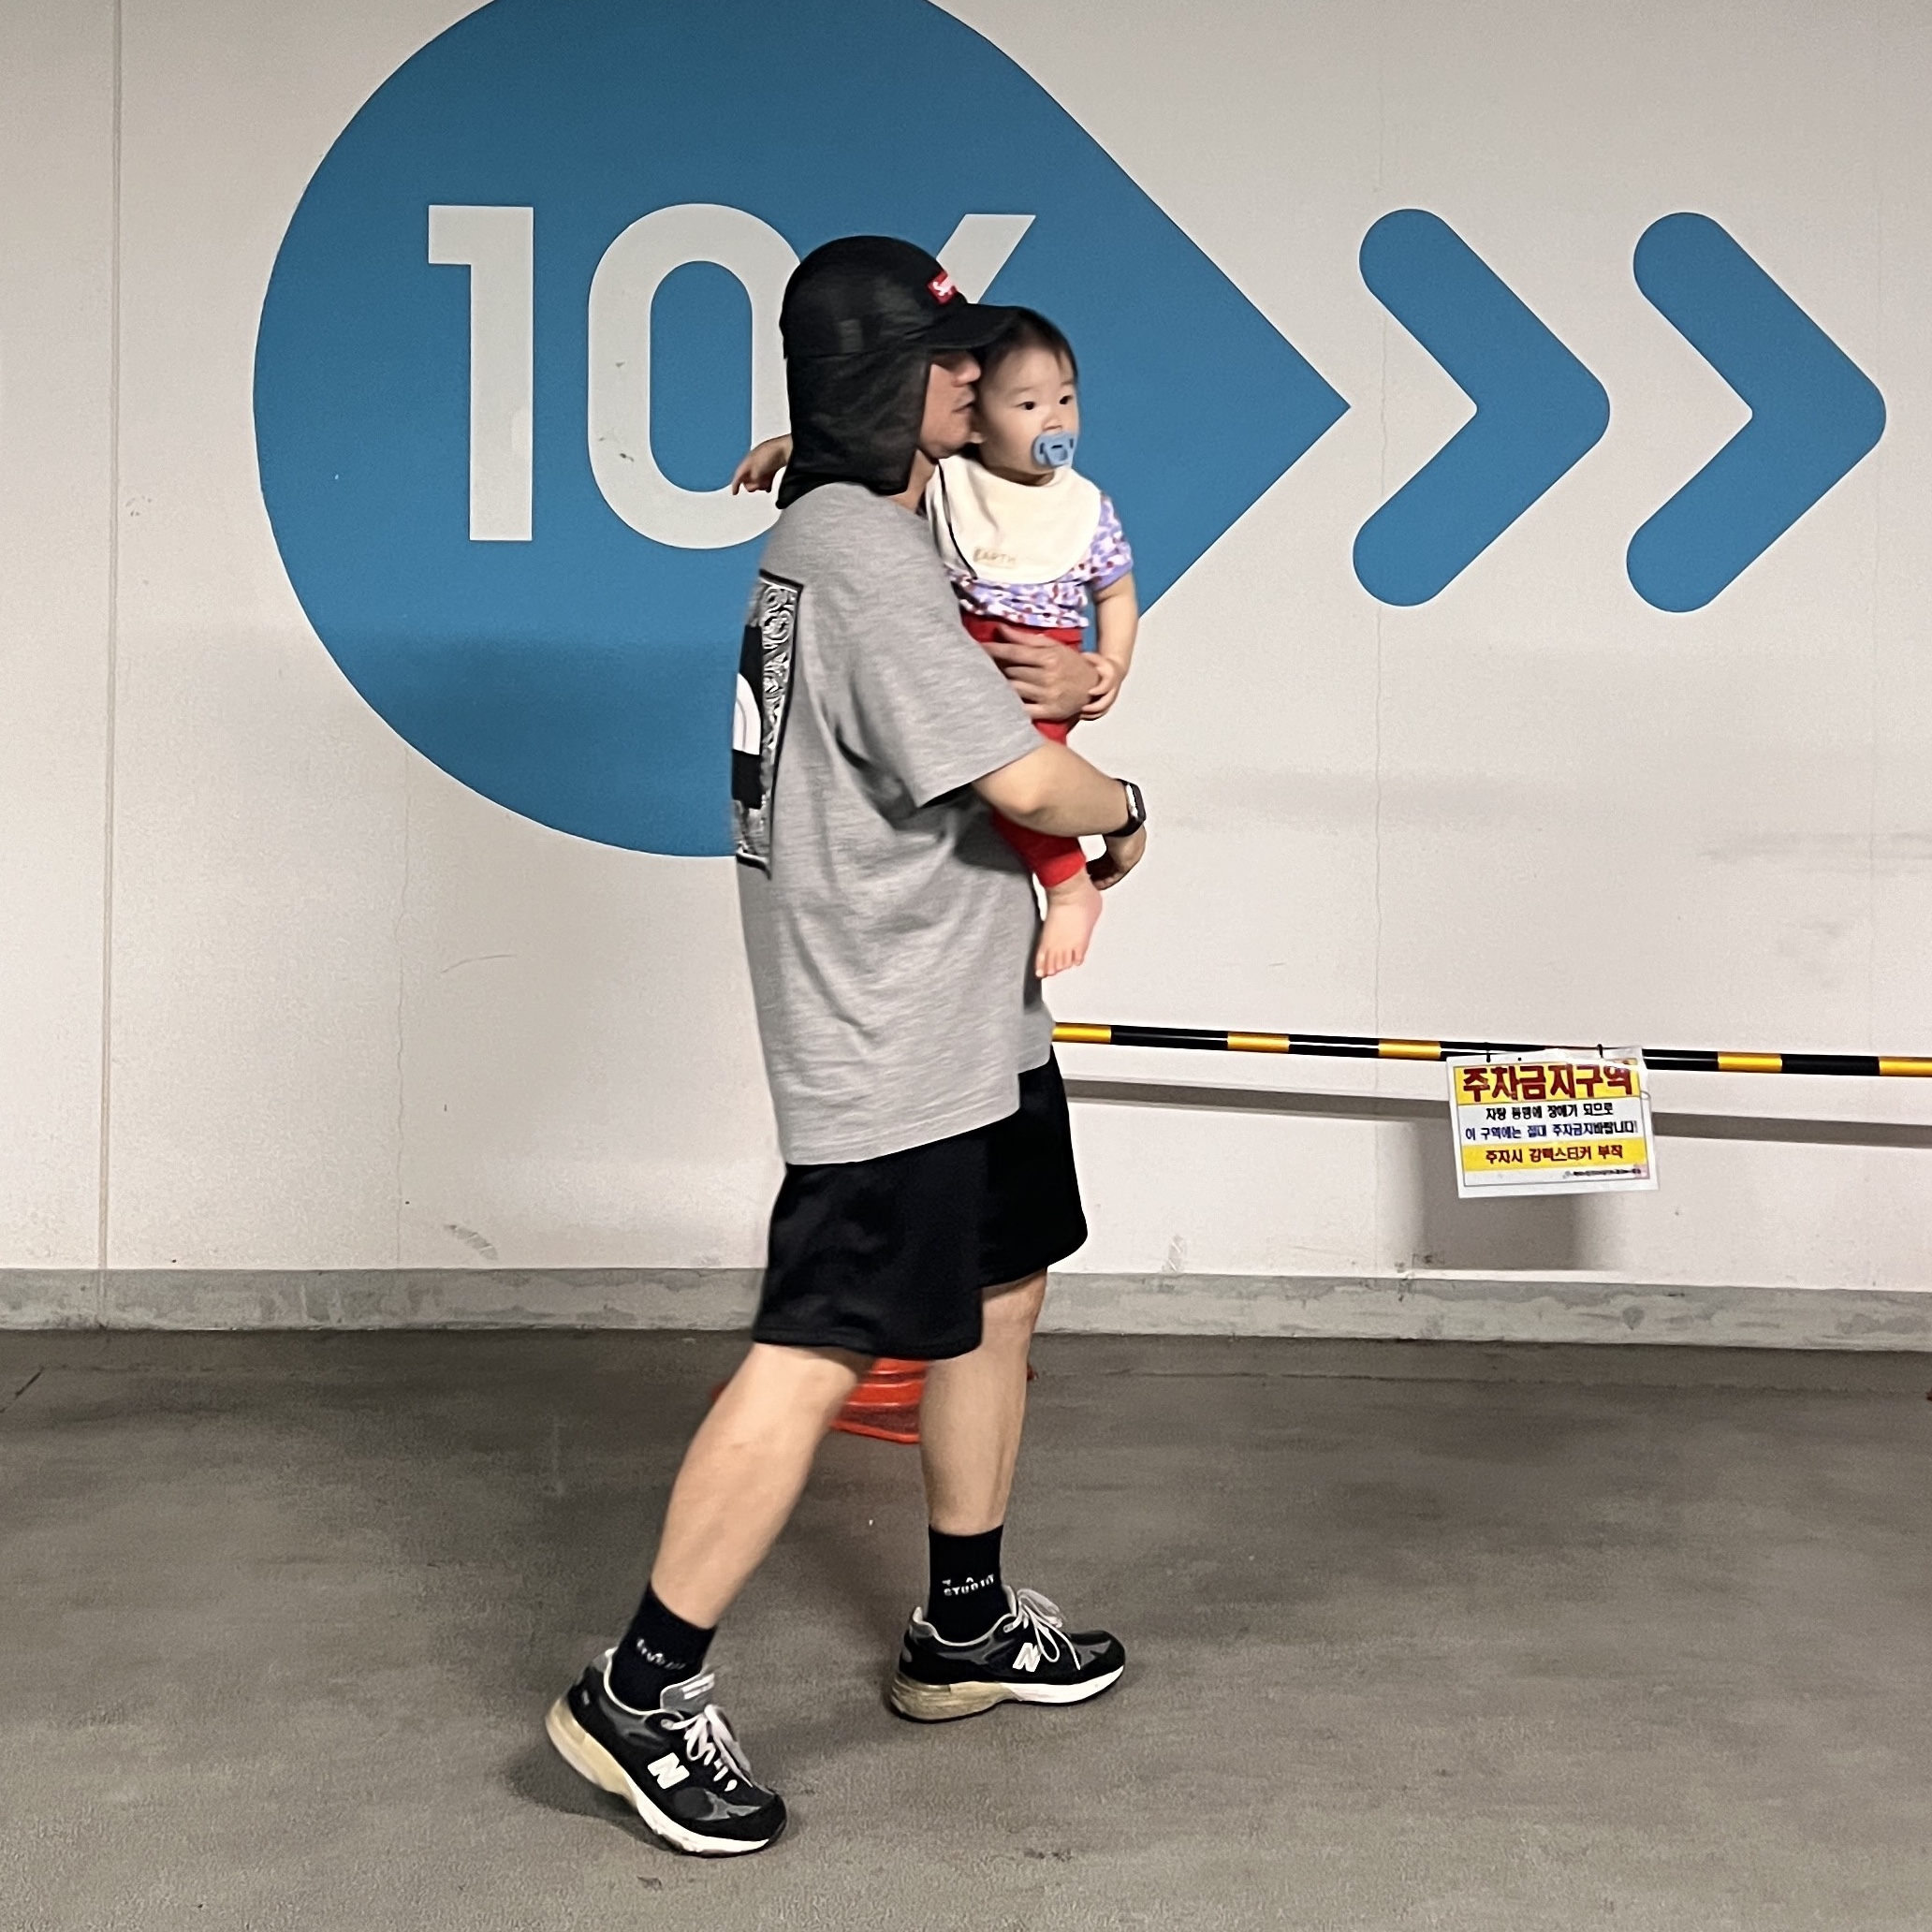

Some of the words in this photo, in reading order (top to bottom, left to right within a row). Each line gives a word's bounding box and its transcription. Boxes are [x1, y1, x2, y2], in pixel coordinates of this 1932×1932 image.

[1463, 1063, 1632, 1102] 주차금지구역
[1466, 1128, 1476, 1141] 이
[647, 1752, 690, 1790] N
